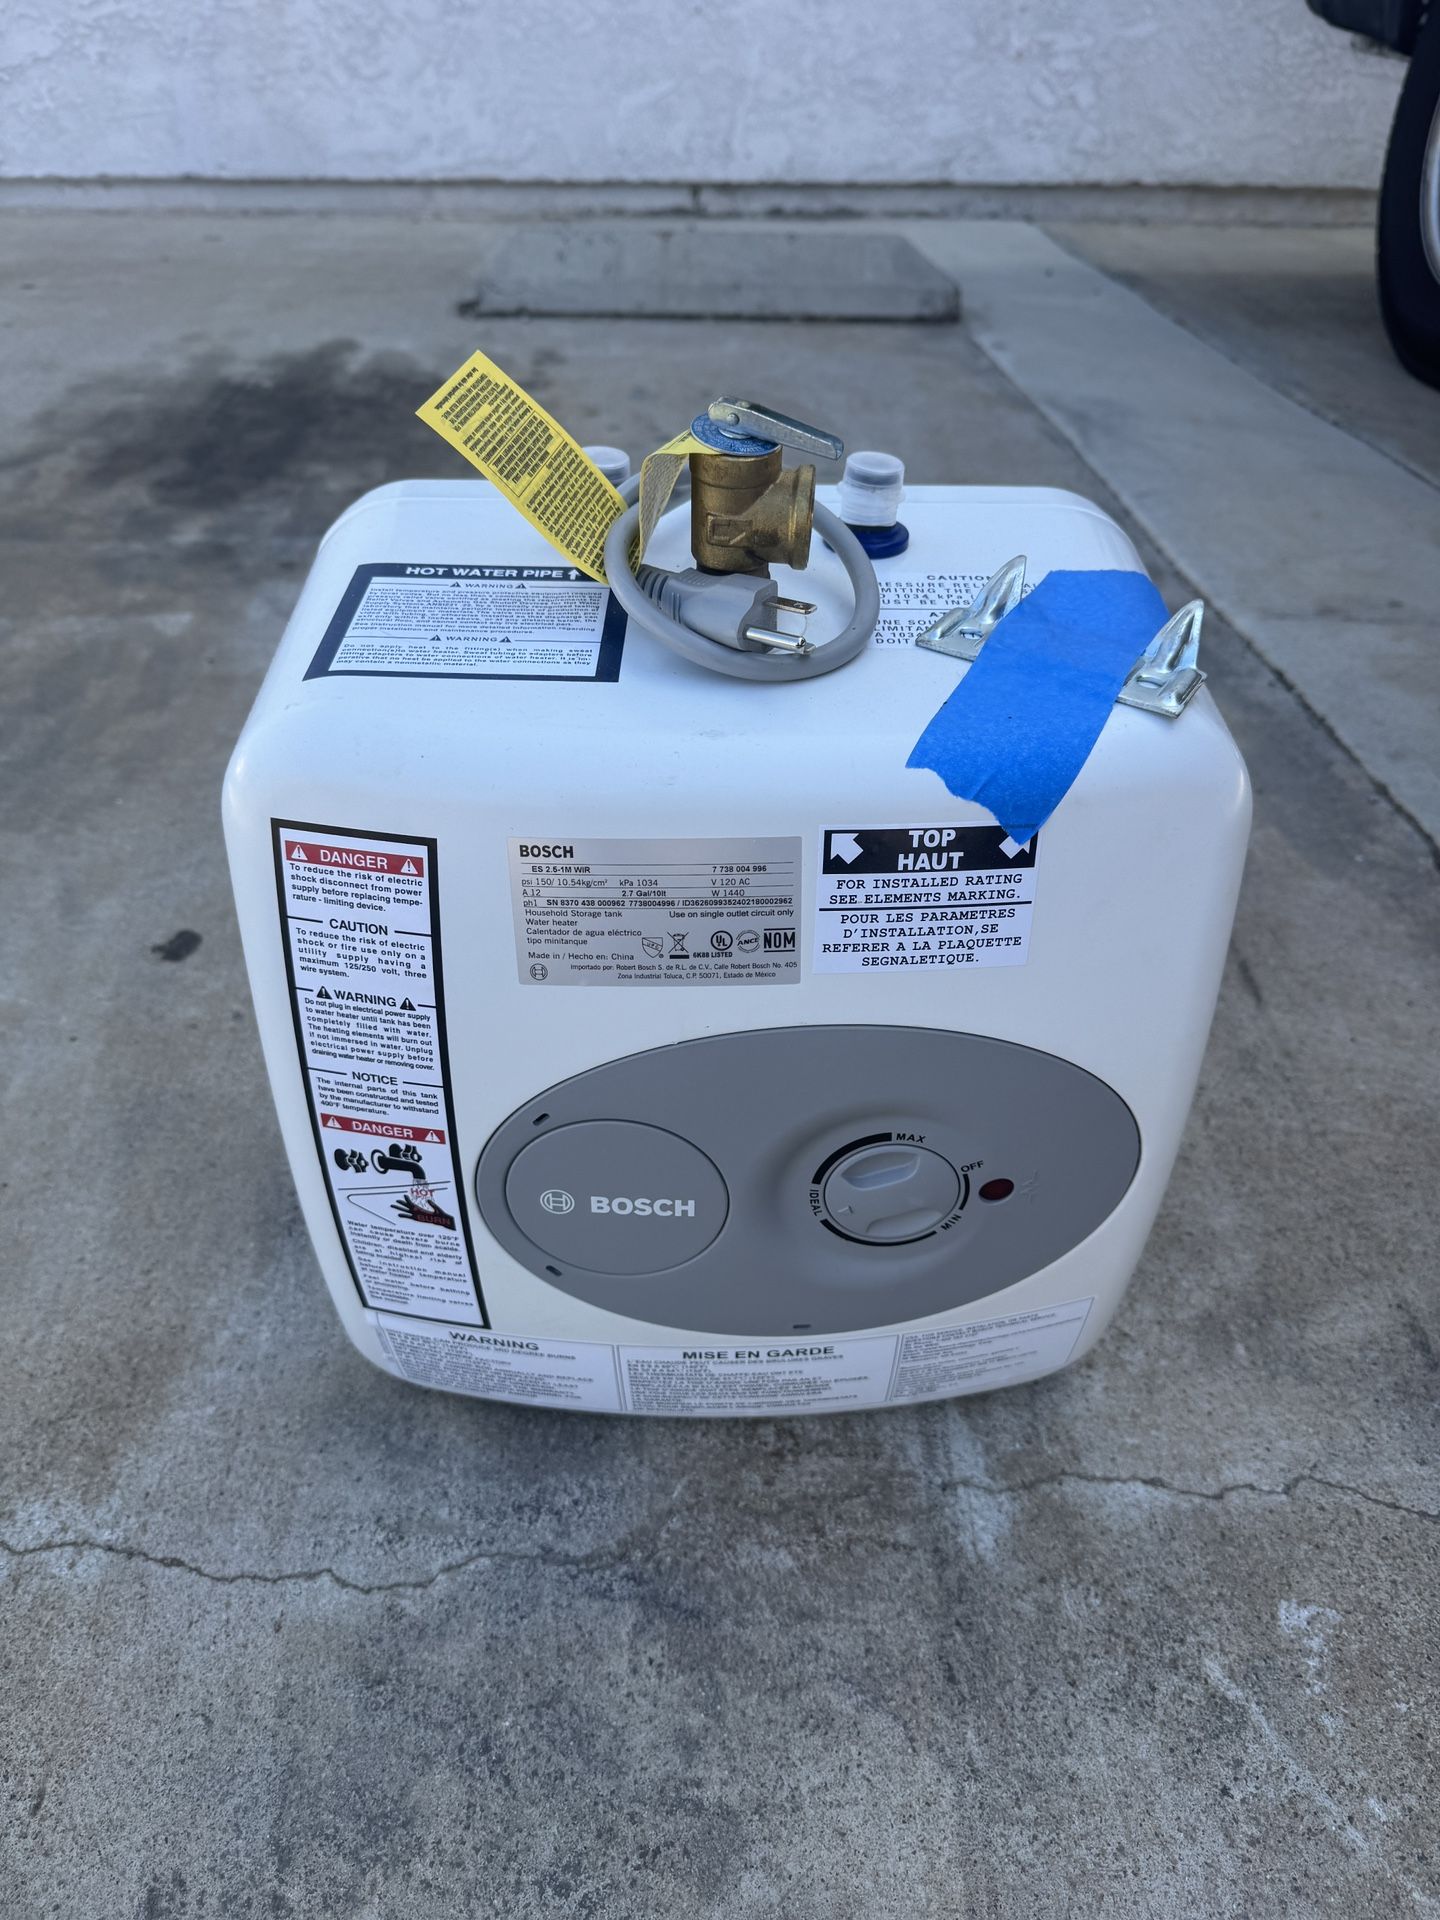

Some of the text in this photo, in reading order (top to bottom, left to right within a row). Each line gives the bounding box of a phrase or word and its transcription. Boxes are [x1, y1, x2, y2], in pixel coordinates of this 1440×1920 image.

[406, 567, 564, 578] HOT WATER PIPE
[909, 829, 957, 848] TOP
[320, 850, 388, 869] DANGER
[520, 845, 574, 858] BOSCH
[898, 852, 964, 871] HAUT
[303, 867, 334, 876] reduce
[337, 870, 351, 878] the
[355, 872, 372, 880] risk
[388, 877, 423, 886] electric
[522, 879, 533, 887] psi
[536, 878, 554, 886] 150/
[836, 874, 1023, 890] FOR INSTALLED RATING
[291, 874, 422, 896] shock disconnect from power
[292, 884, 319, 894] supply
[322, 887, 348, 896] before
[351, 891, 390, 904] replacing
[829, 889, 1021, 905] SEE ELEMENTS MARKING.
[571, 910, 601, 918] Storage
[700, 911, 725, 920] single
[777, 909, 794, 917] only
[841, 909, 1016, 924] POUR LES PARAMETRES
[329, 919, 388, 935] CAUTION
[296, 927, 306, 935] To
[309, 930, 339, 940] reduce
[359, 937, 376, 945] risk
[391, 941, 425, 951] electric
[764, 932, 795, 948] NOM
[822, 937, 1022, 953] REFERER A LA PLAQUETTE
[297, 938, 325, 947] shock
[341, 943, 357, 952] fire
[381, 949, 401, 959] only
[299, 947, 327, 957] utility
[337, 953, 369, 963] supply
[378, 958, 411, 969] having
[861, 953, 979, 966] SEGNALETIQUE.
[299, 956, 339, 967] maximum
[344, 962, 376, 972] 125/250
[404, 970, 427, 978] three
[334, 989, 397, 1007] WARNING
[352, 1071, 398, 1086] NOTICE
[352, 1121, 413, 1138] DANGER
[896, 1132, 927, 1143] MAX
[960, 1160, 985, 1173] OFF
[411, 1188, 433, 1196] HOT
[590, 1196, 695, 1217] BOSCH
[809, 1189, 823, 1217] IDEAL
[940, 1214, 962, 1232] MIN
[449, 1331, 539, 1350] WARNING
[683, 1346, 834, 1359] MISE EN GARDE
